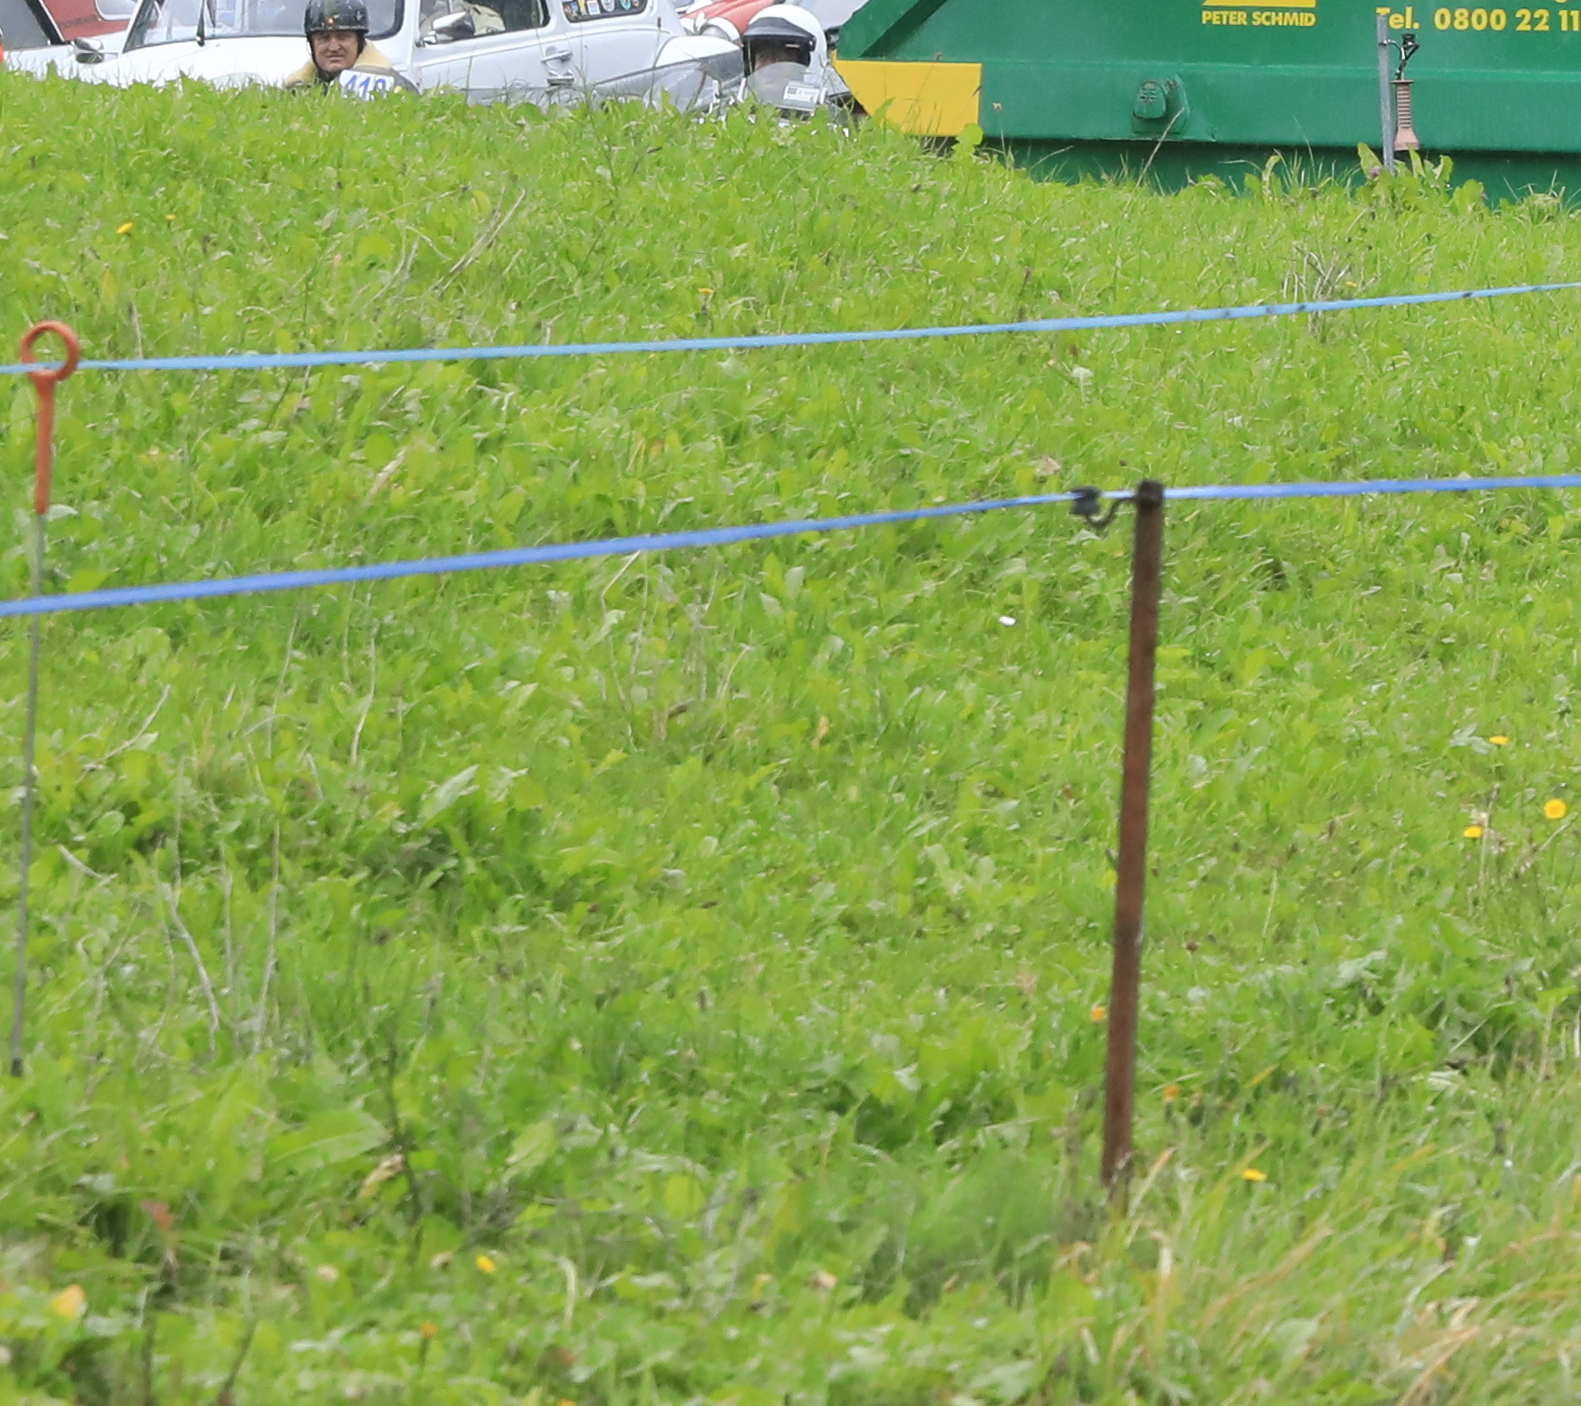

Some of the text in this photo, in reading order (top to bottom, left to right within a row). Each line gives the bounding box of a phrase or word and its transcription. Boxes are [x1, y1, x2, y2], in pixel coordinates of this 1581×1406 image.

[1201, 10, 1316, 27] PETER SCHMID
[1376, 8, 1420, 31] Tel.
[1434, 8, 1507, 31] 0800
[1515, 9, 1550, 31] 22
[1559, 9, 1580, 32] 11
